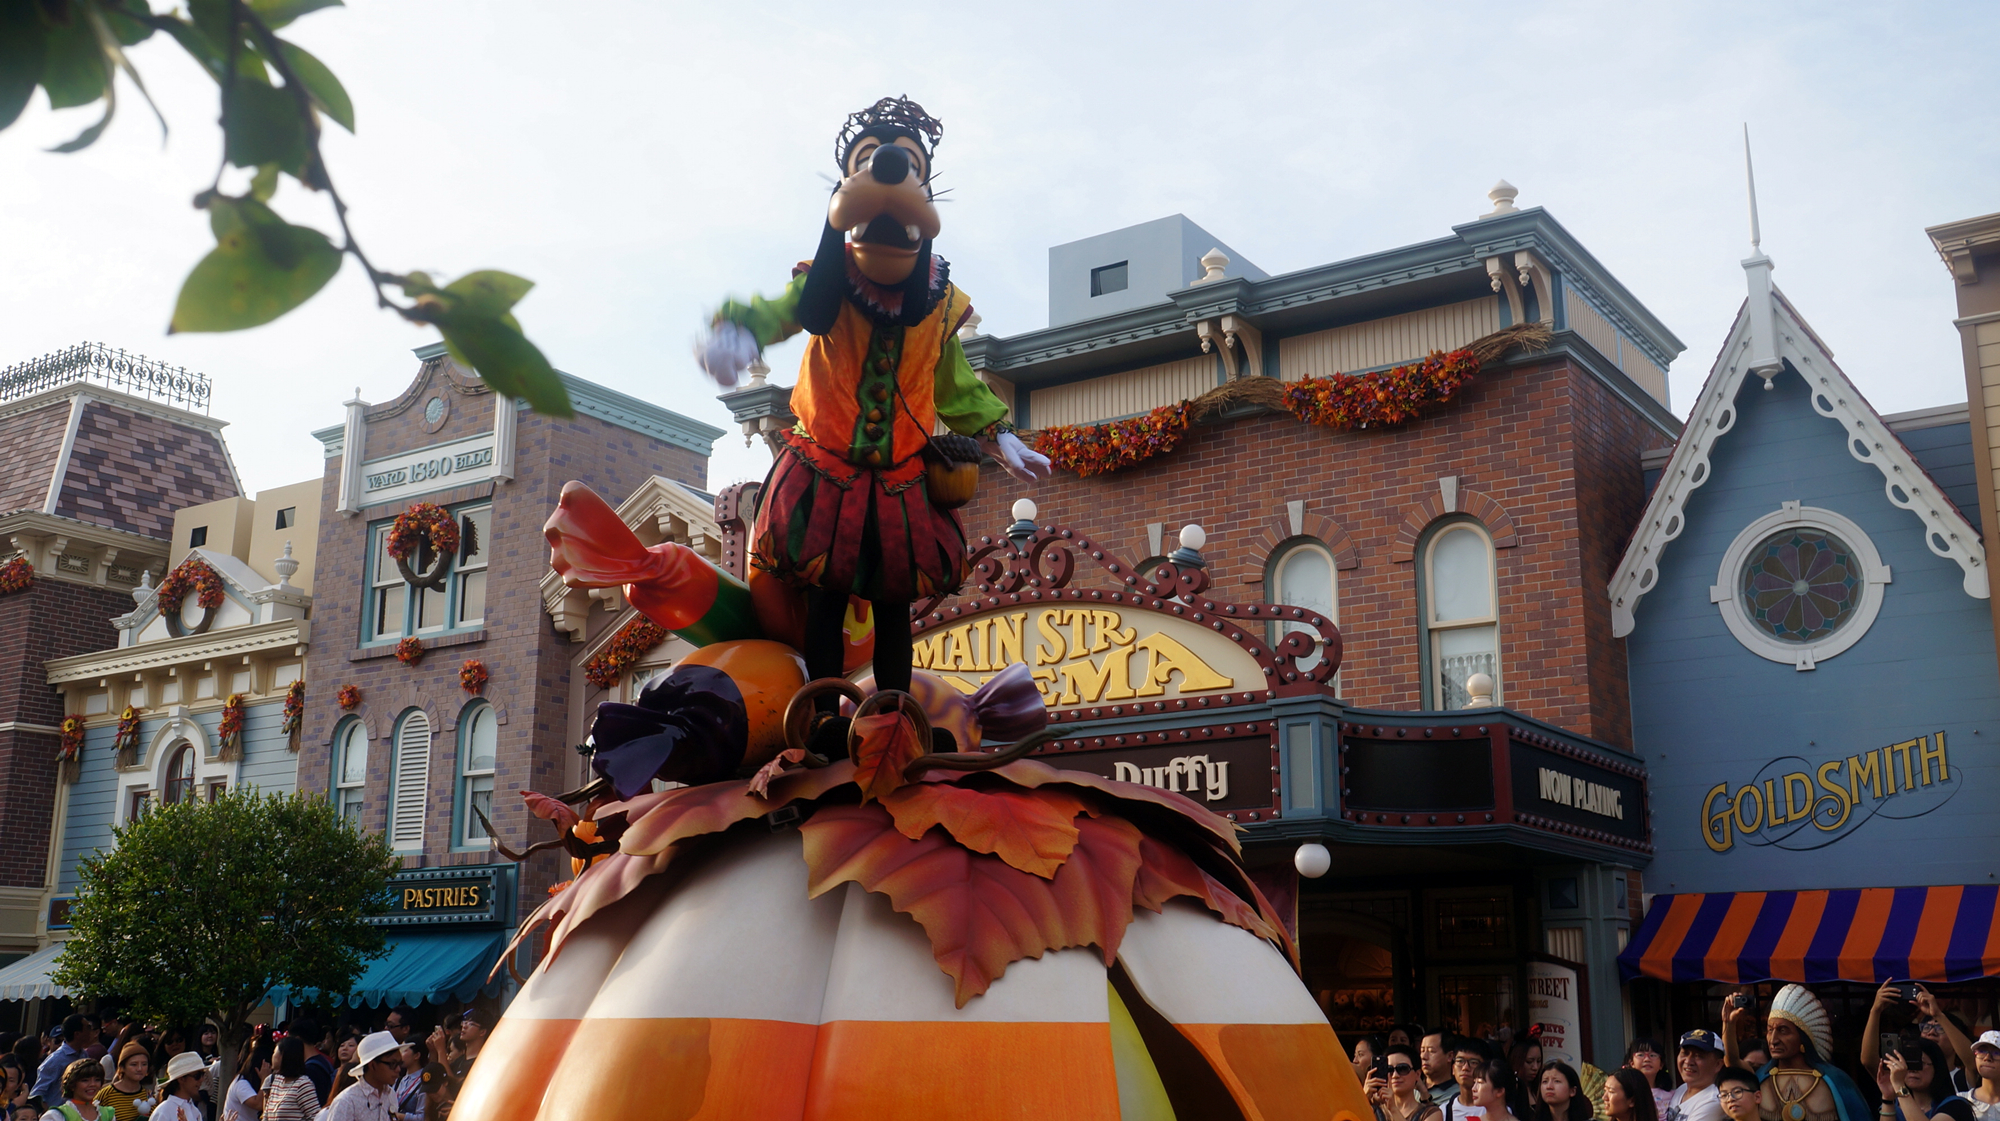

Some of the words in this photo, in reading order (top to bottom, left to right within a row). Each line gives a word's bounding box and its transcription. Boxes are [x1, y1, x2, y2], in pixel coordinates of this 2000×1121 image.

[366, 471, 406, 489] WARD
[408, 456, 452, 483] 1890
[912, 612, 1028, 672] MAIN
[1036, 609, 1137, 666] STR
[1114, 754, 1230, 802] Duffy
[1539, 767, 1571, 806] NOW
[1573, 778, 1623, 820] PLAYING
[1701, 730, 1950, 852] GOLDSMITH
[403, 886, 480, 910] PASTRIES
[1528, 977, 1570, 1001] STREET
